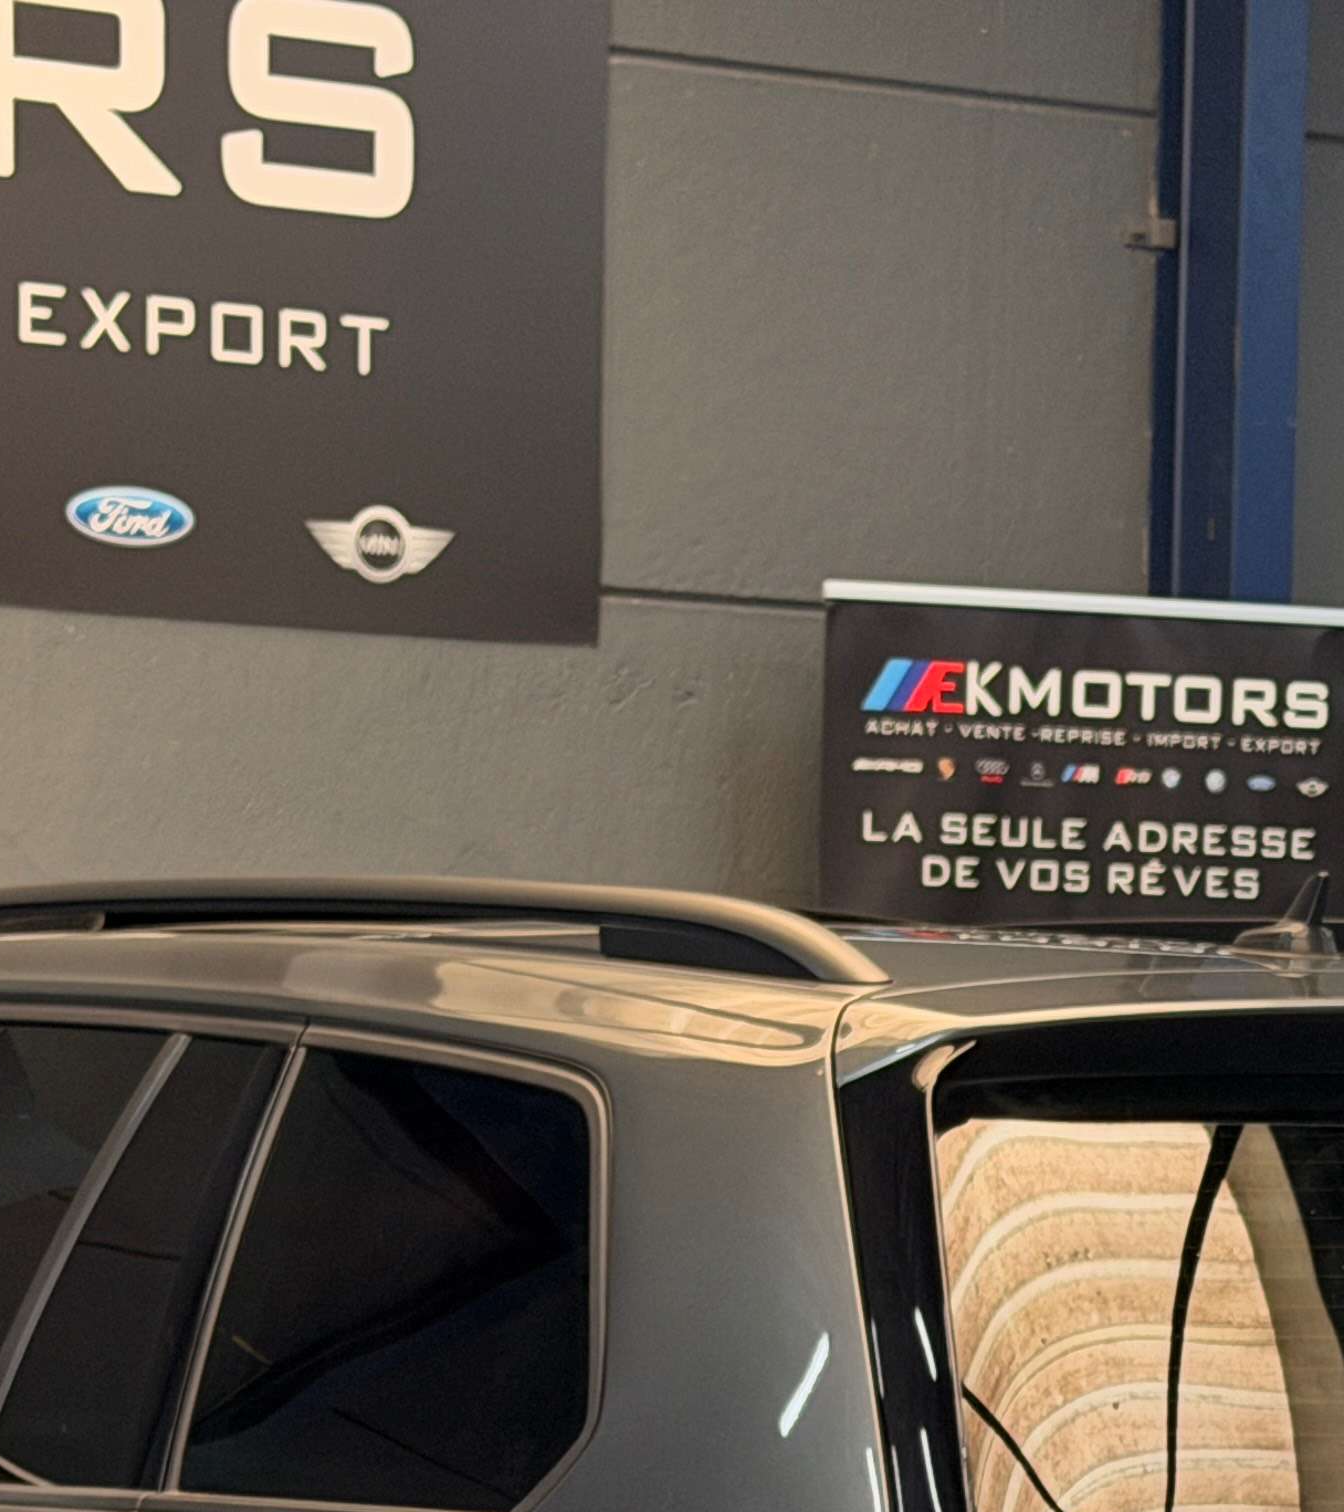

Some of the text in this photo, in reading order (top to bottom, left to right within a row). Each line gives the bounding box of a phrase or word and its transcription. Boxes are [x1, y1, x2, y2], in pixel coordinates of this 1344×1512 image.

[17, 280, 390, 376] EXPORT
[864, 719, 939, 736] ACHAT
[958, 722, 1026, 742] VENTE
[1146, 732, 1221, 750] IMPORT
[1239, 735, 1322, 755] EXPORT
[862, 811, 1315, 861] LA SEULE ADRESSE
[921, 855, 1259, 900] DE VOS RÊVES
